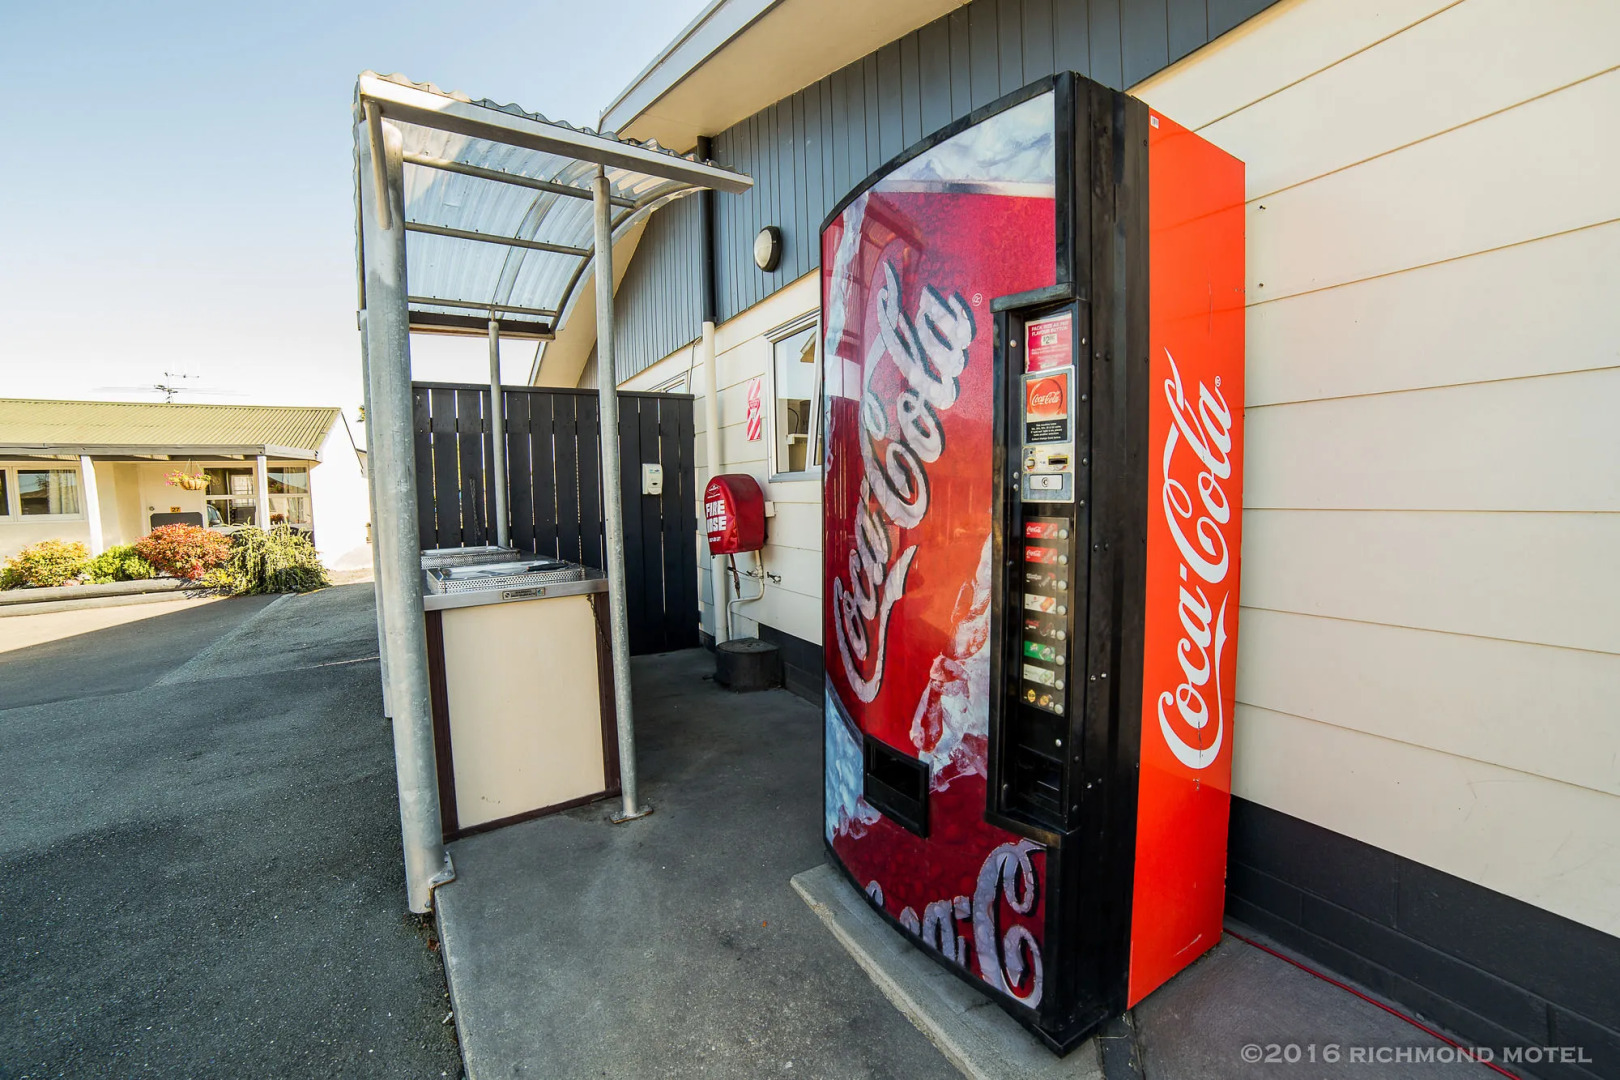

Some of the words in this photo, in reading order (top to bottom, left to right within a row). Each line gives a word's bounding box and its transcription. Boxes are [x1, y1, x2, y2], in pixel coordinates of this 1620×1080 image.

[706, 500, 725, 518] FIRE
[707, 516, 727, 533] OSE
[1158, 346, 1233, 770] Coca-Cola
